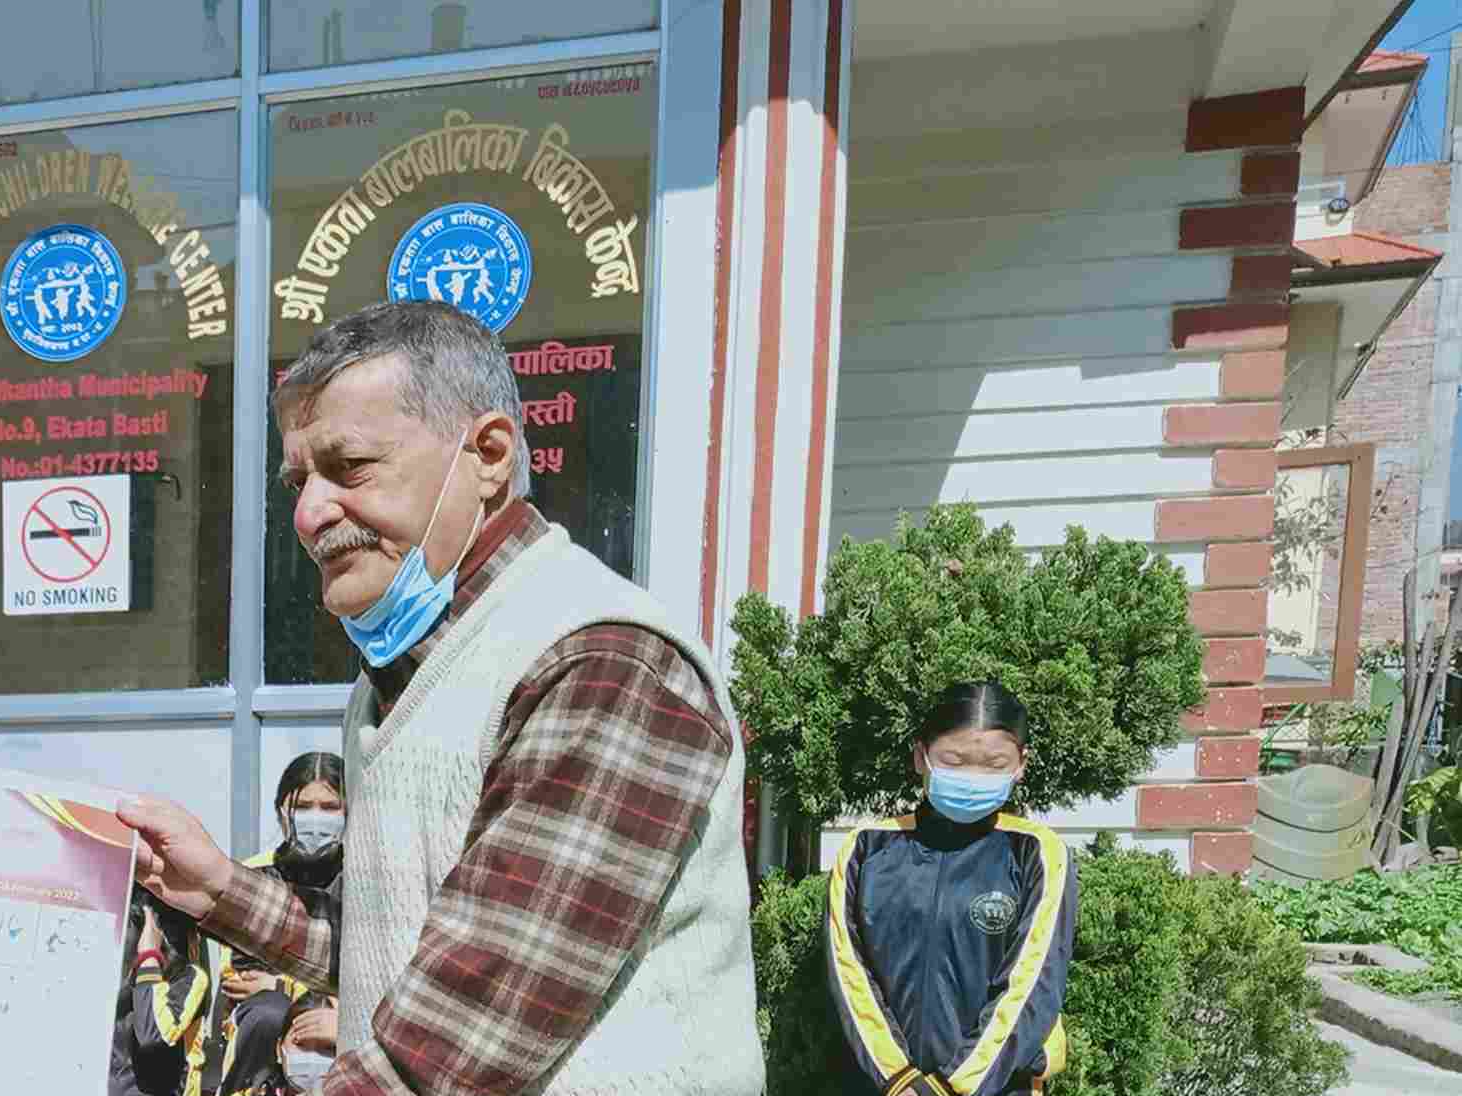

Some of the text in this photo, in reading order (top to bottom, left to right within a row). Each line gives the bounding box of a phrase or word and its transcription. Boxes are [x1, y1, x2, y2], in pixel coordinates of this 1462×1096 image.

[522, 122, 615, 234] विकास
[298, 186, 376, 277] एकता
[170, 229, 227, 339] CENTER
[274, 276, 329, 323] श्री
[506, 341, 615, 376] पालिका
[47, 414, 107, 440] Ekata
[113, 409, 170, 436] Basti
[14, 586, 118, 607] NO SMOKING
